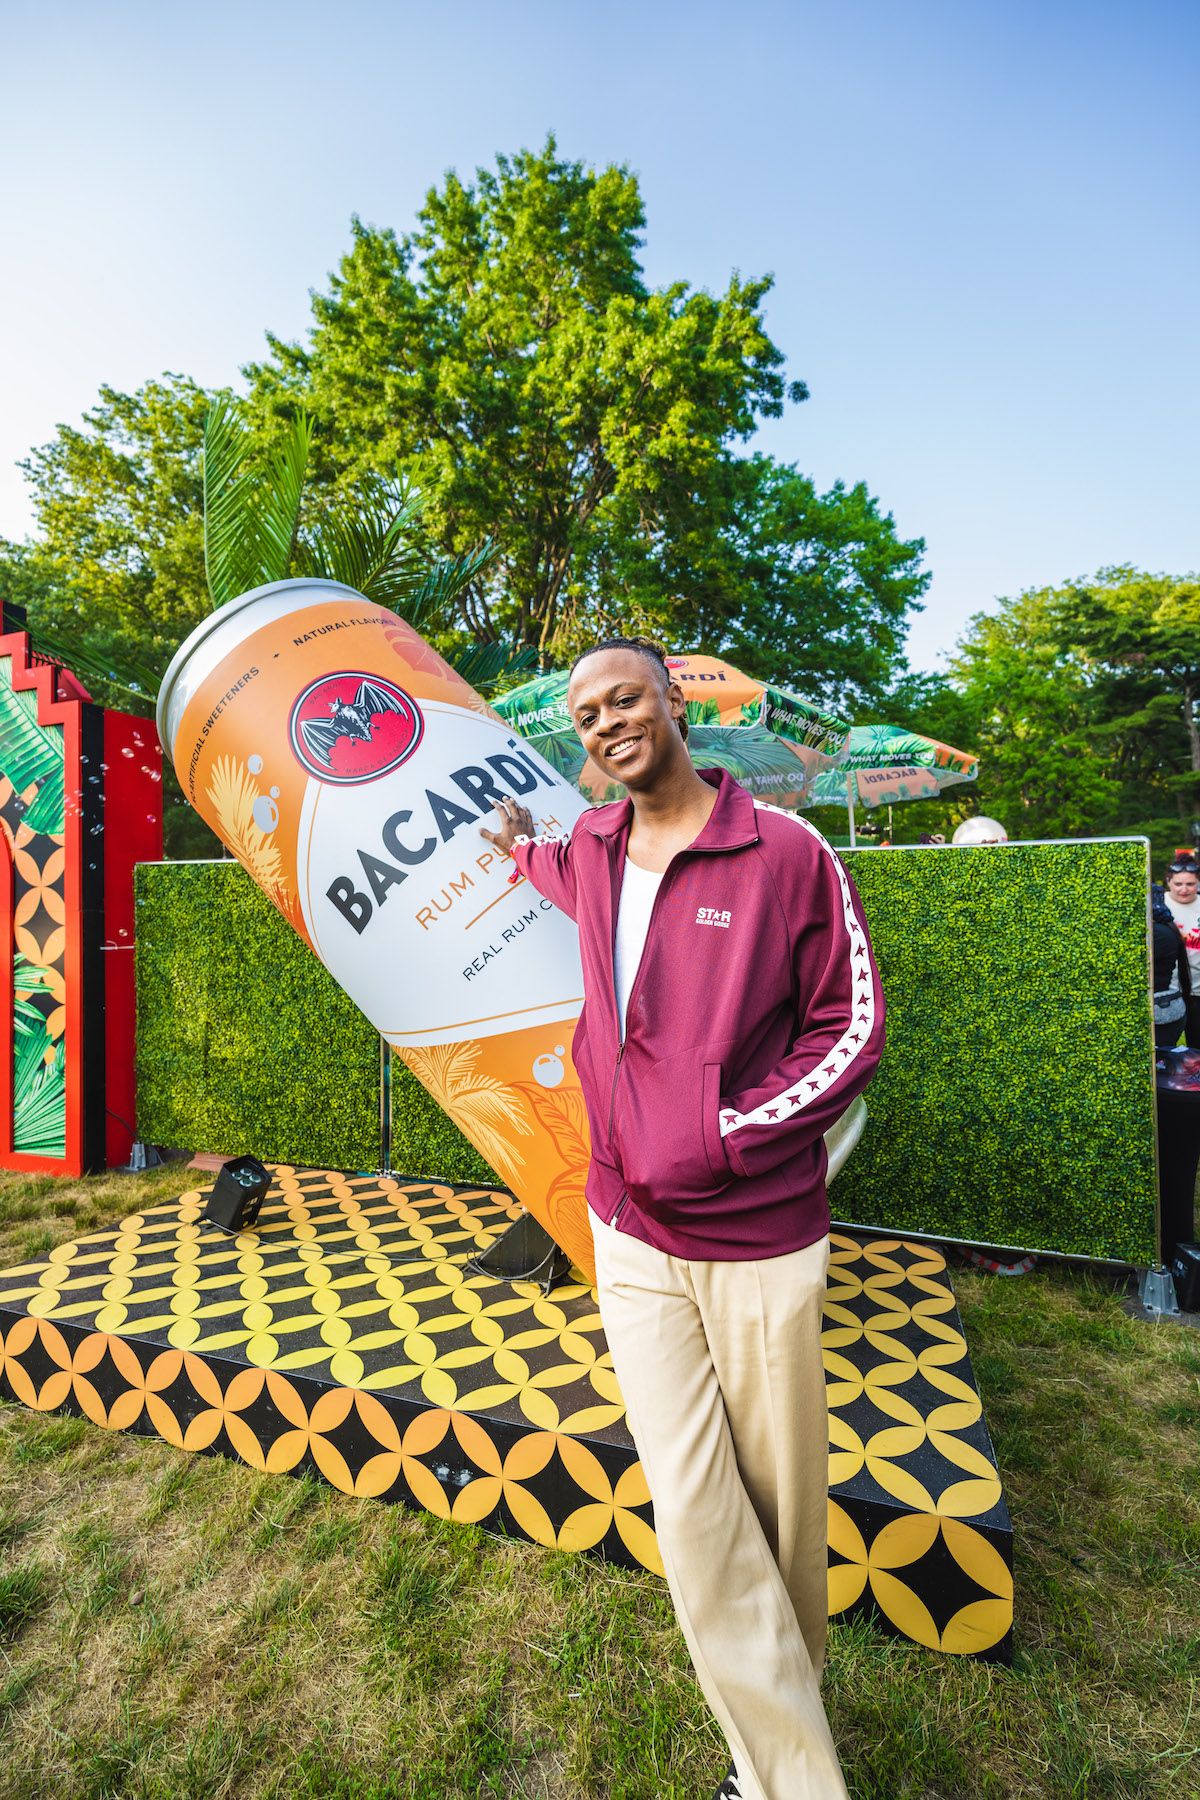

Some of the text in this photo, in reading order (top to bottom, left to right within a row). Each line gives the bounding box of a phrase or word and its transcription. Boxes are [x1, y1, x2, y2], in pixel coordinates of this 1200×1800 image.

[293, 621, 350, 646] NATURAL
[189, 738, 206, 791] ARTIFICIAL
[203, 667, 260, 737] SWEETENERS
[518, 707, 554, 727] MOVES
[770, 707, 798, 725] WHAT
[795, 717, 826, 737] MOVES
[824, 729, 845, 745] YOU
[850, 751, 935, 763] WHAT MOVES YOU
[326, 738, 556, 935] BACARDÍ
[415, 871, 475, 931] RUM
[462, 945, 503, 981] REAL
[502, 910, 538, 942] RUM
